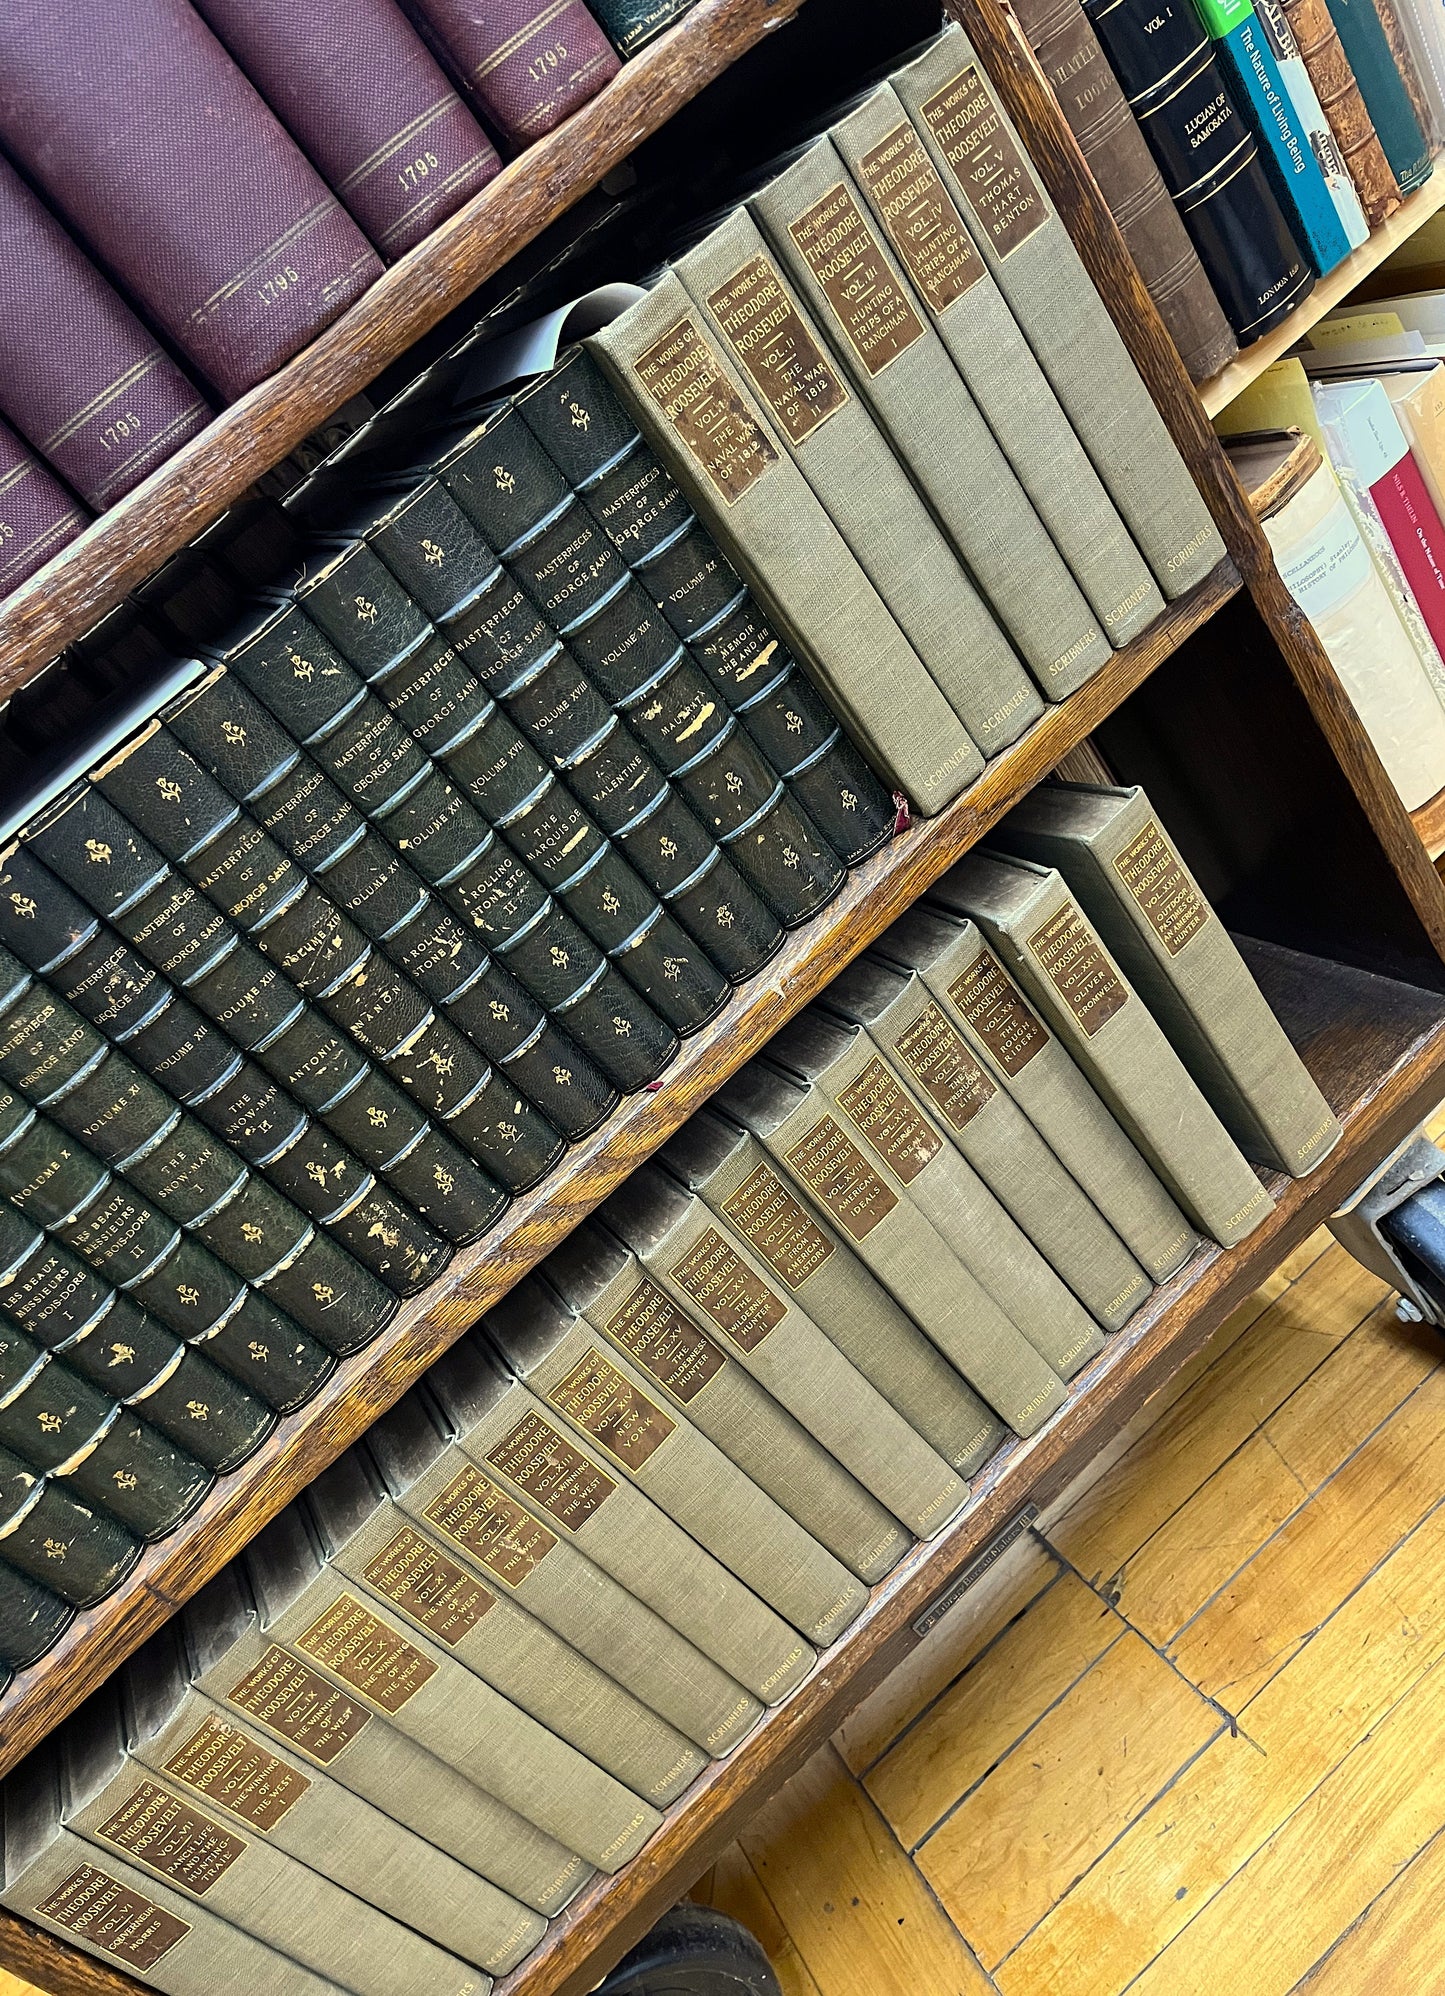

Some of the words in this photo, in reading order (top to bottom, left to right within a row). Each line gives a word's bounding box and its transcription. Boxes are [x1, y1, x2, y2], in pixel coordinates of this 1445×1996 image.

[1143, 15, 1166, 36] VOL
[1165, 7, 1173, 17] I
[1238, 26, 1256, 52] The
[526, 40, 569, 82] 1795
[1248, 49, 1273, 92] Nature
[927, 104, 945, 125] THE
[942, 82, 970, 112] WORKS
[966, 74, 979, 90] OF
[937, 91, 989, 147] THEODORE
[1183, 102, 1217, 134] LUCIAN
[1214, 92, 1227, 106] OF
[1264, 90, 1280, 105] of
[947, 112, 1001, 168] ROOSEVELT
[1189, 105, 1233, 148] SAMOSATA
[1270, 102, 1293, 141] Living
[395, 149, 440, 191] 1795
[1285, 138, 1306, 174] Being
[979, 165, 1021, 209] THOMAS
[991, 183, 1022, 217] HART
[806, 210, 861, 264] THEODORE
[993, 192, 1034, 236] BENTON
[817, 230, 872, 284] ROOSEVELT
[255, 264, 300, 307] 1795
[722, 279, 780, 335] THEODORE
[849, 284, 894, 326] HUNTING
[1256, 275, 1290, 304] LONDON
[735, 298, 793, 354] ROOSEVELT
[862, 307, 909, 352] RANCHMAN
[773, 379, 806, 409] NAVAL
[803, 361, 826, 384] WAR
[780, 361, 803, 384] THE
[786, 401, 801, 417] OF
[804, 378, 828, 401] 1812
[97, 410, 141, 452] 1795
[601, 466, 661, 519] MASTERPIECES
[534, 528, 594, 582] MASTERPIECES
[1165, 524, 1214, 572] SCRIBNERS
[1414, 527, 1424, 538] On
[545, 570, 590, 611] GEORGE
[588, 549, 613, 573] SAND
[1103, 578, 1153, 627] SCRIBNERS
[454, 590, 525, 652] MASTERPIECES
[600, 634, 637, 666] VOLUME
[636, 619, 653, 635] XIX
[719, 623, 757, 659] MEMOIR
[1047, 628, 1098, 677] SCRIBNERS
[387, 648, 456, 711] MASTERPIECES
[532, 699, 570, 733] VOLUME
[568, 681, 590, 701] XVIII
[980, 685, 1031, 734] SCRIBNERS
[333, 713, 395, 769] MASTERPIECES
[352, 756, 393, 794] GEORGE
[390, 736, 414, 760] SAND
[470, 756, 508, 791] VOLUME
[506, 740, 525, 758] XVII
[592, 754, 643, 803] VALENTINE
[264, 771, 325, 828] MASTERPIECES
[526, 821, 570, 862] MARQUIS
[1124, 838, 1164, 883] THEODORE
[1132, 851, 1172, 896] ROOSEVELT
[131, 886, 196, 944] MASTERPIECES
[1156, 887, 1188, 922] OUTDOOR
[160, 938, 201, 973] GEORGE
[198, 914, 227, 940] SAND
[1172, 915, 1200, 945] HUNTER
[1049, 931, 1092, 977] ROOSEVELT
[217, 986, 261, 1024] VOLUME
[259, 970, 277, 986] XIII
[958, 965, 999, 1010] THEODORE
[967, 977, 1009, 1023] ROOSEVELT
[1073, 969, 1105, 1005] OLIVER
[1077, 975, 1117, 1018] CROMWELL
[287, 1036, 339, 1084] ANTONIA
[1000, 1021, 1029, 1053] ROUGH
[1004, 1025, 1038, 1063] RIDERS
[83, 1095, 129, 1138] VOLUME
[128, 1083, 141, 1096] XI
[225, 1085, 279, 1136] SNOW-MAN
[850, 1072, 891, 1119] THEODORE
[860, 1084, 901, 1131] ROOSEVELT
[800, 1130, 843, 1176] THEODORE
[1295, 1116, 1334, 1159] SCRIBNERS
[158, 1148, 213, 1199] SNOW-MAN
[810, 1141, 854, 1188] ROOSEVELT
[89, 1194, 126, 1230] BEAUX
[735, 1179, 779, 1226] THEODORE
[745, 1190, 789, 1237] ROOSEVELT
[837, 1173, 875, 1212] AMERICAN
[850, 1185, 881, 1217] IDEALS
[1223, 1187, 1267, 1230] SCRIBNERS
[83, 1204, 136, 1255] MESSIEURS
[104, 1209, 151, 1258] BOIS-DORE
[770, 1241, 791, 1262] HERO
[789, 1218, 812, 1243] TALES
[787, 1236, 808, 1259] FROM
[683, 1242, 730, 1291] THEODORE
[695, 1253, 740, 1302] ROOSEVELT
[785, 1237, 822, 1274] AMERICAN
[794, 1246, 827, 1279] HISTORY
[620, 1293, 663, 1344] THEODORE
[631, 1303, 675, 1355] ROOSEVELT
[728, 1288, 770, 1334] WILDERNESS
[740, 1303, 771, 1336] HUNTER
[666, 1338, 707, 1385] WILDERNESS
[678, 1353, 709, 1386] HUNTER
[564, 1363, 612, 1414] THEODORE
[576, 1374, 623, 1424] ROOSEVELT
[1015, 1377, 1056, 1422] SCRIBNERS
[616, 1410, 641, 1436] NEW
[623, 1416, 654, 1449] YORK
[502, 1425, 550, 1474] THEODORE
[514, 1435, 562, 1484] ROOSEVELT
[440, 1478, 489, 1529] THEODORE
[544, 1490, 560, 1507] THE
[557, 1459, 590, 1493] WINNING
[563, 1497, 582, 1516] THE
[579, 1476, 601, 1499] WEST
[453, 1488, 503, 1540] ROOSEVELT
[377, 1541, 427, 1590] THEODORE
[390, 1550, 440, 1600] ROOSEVELT
[244, 1659, 296, 1712] THEODORE
[259, 1668, 310, 1721] ROOSEVELT
[706, 1697, 750, 1745] SCRIBNERS
[195, 1735, 248, 1789] ROOSEVELT
[116, 1792, 169, 1845] THEODORE
[130, 1801, 184, 1854] ROOSEVELT
[600, 1812, 645, 1861] SCRIBNERS
[166, 1845, 195, 1873] RANCH
[193, 1824, 215, 1845] LIFE
[180, 1854, 201, 1873] AND
[197, 1836, 218, 1855] THE
[187, 1835, 233, 1882] HUNTING-
[54, 1875, 109, 1922] THEODORE
[69, 1883, 124, 1932] ROOSEVELT
[107, 1906, 156, 1950] GOUVERNEUR
[128, 1919, 161, 1950] MORRIS
